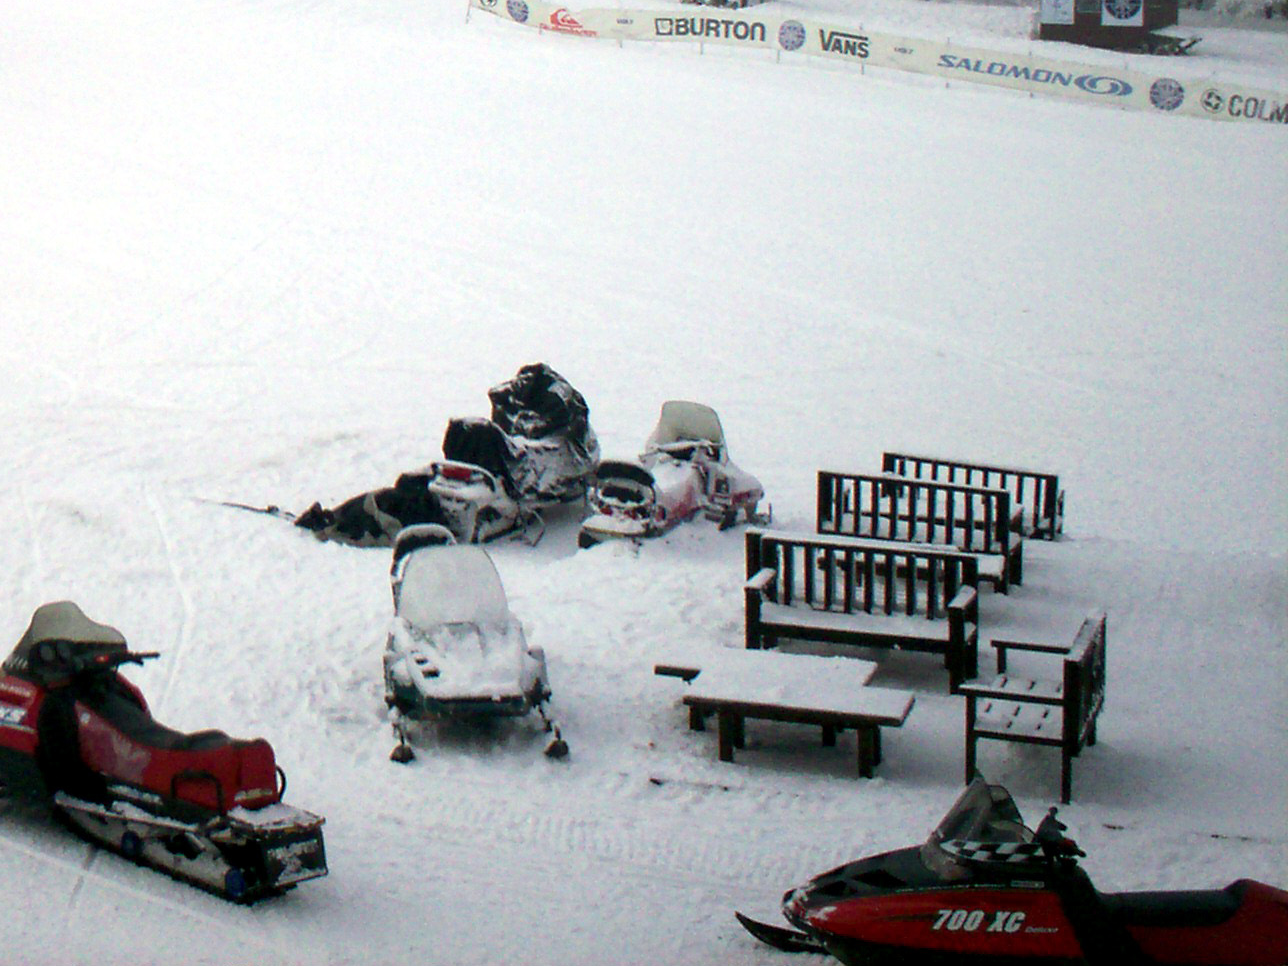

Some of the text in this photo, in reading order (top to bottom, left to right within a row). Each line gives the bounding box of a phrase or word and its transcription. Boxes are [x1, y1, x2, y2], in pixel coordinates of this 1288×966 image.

[675, 17, 766, 42] BURTON
[818, 28, 870, 59] VANS
[937, 53, 1073, 87] SALOMON
[932, 909, 985, 932] 700
[986, 910, 1027, 933] XC
